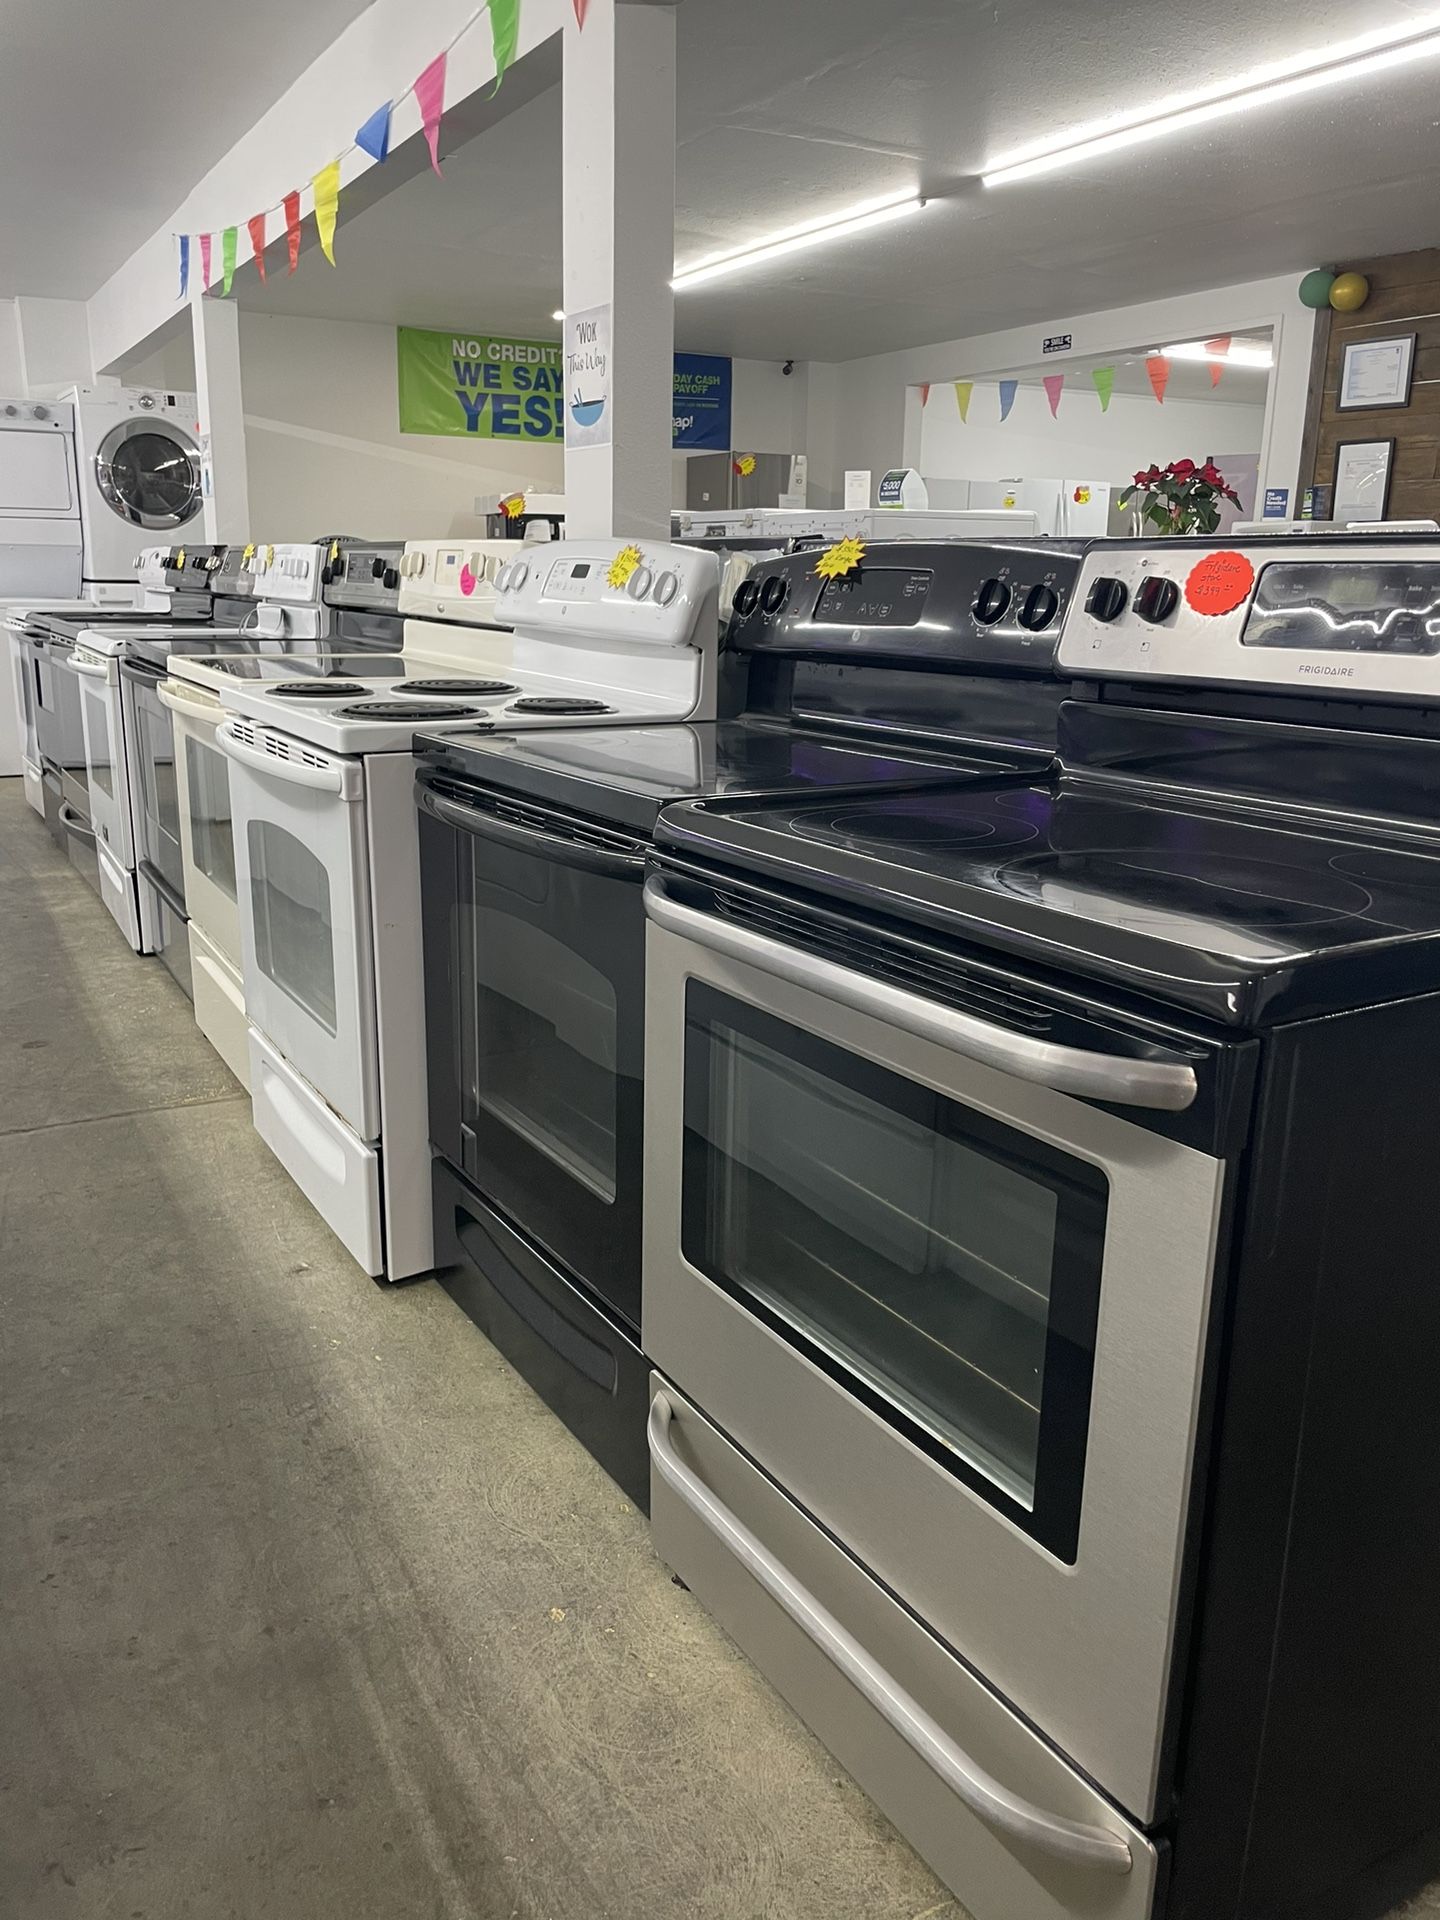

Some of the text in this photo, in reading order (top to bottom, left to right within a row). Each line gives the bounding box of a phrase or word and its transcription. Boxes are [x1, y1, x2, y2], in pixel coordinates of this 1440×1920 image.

[576, 321, 597, 345] WOK
[452, 339, 564, 364] NO CREDIT
[567, 347, 606, 377] This Way
[453, 360, 564, 393] WE SAY
[673, 374, 720, 385] DAY CASH
[673, 384, 709, 394] PAYOFF
[454, 390, 564, 438] YES!
[1298, 664, 1355, 677] FRIGIDAIRE
